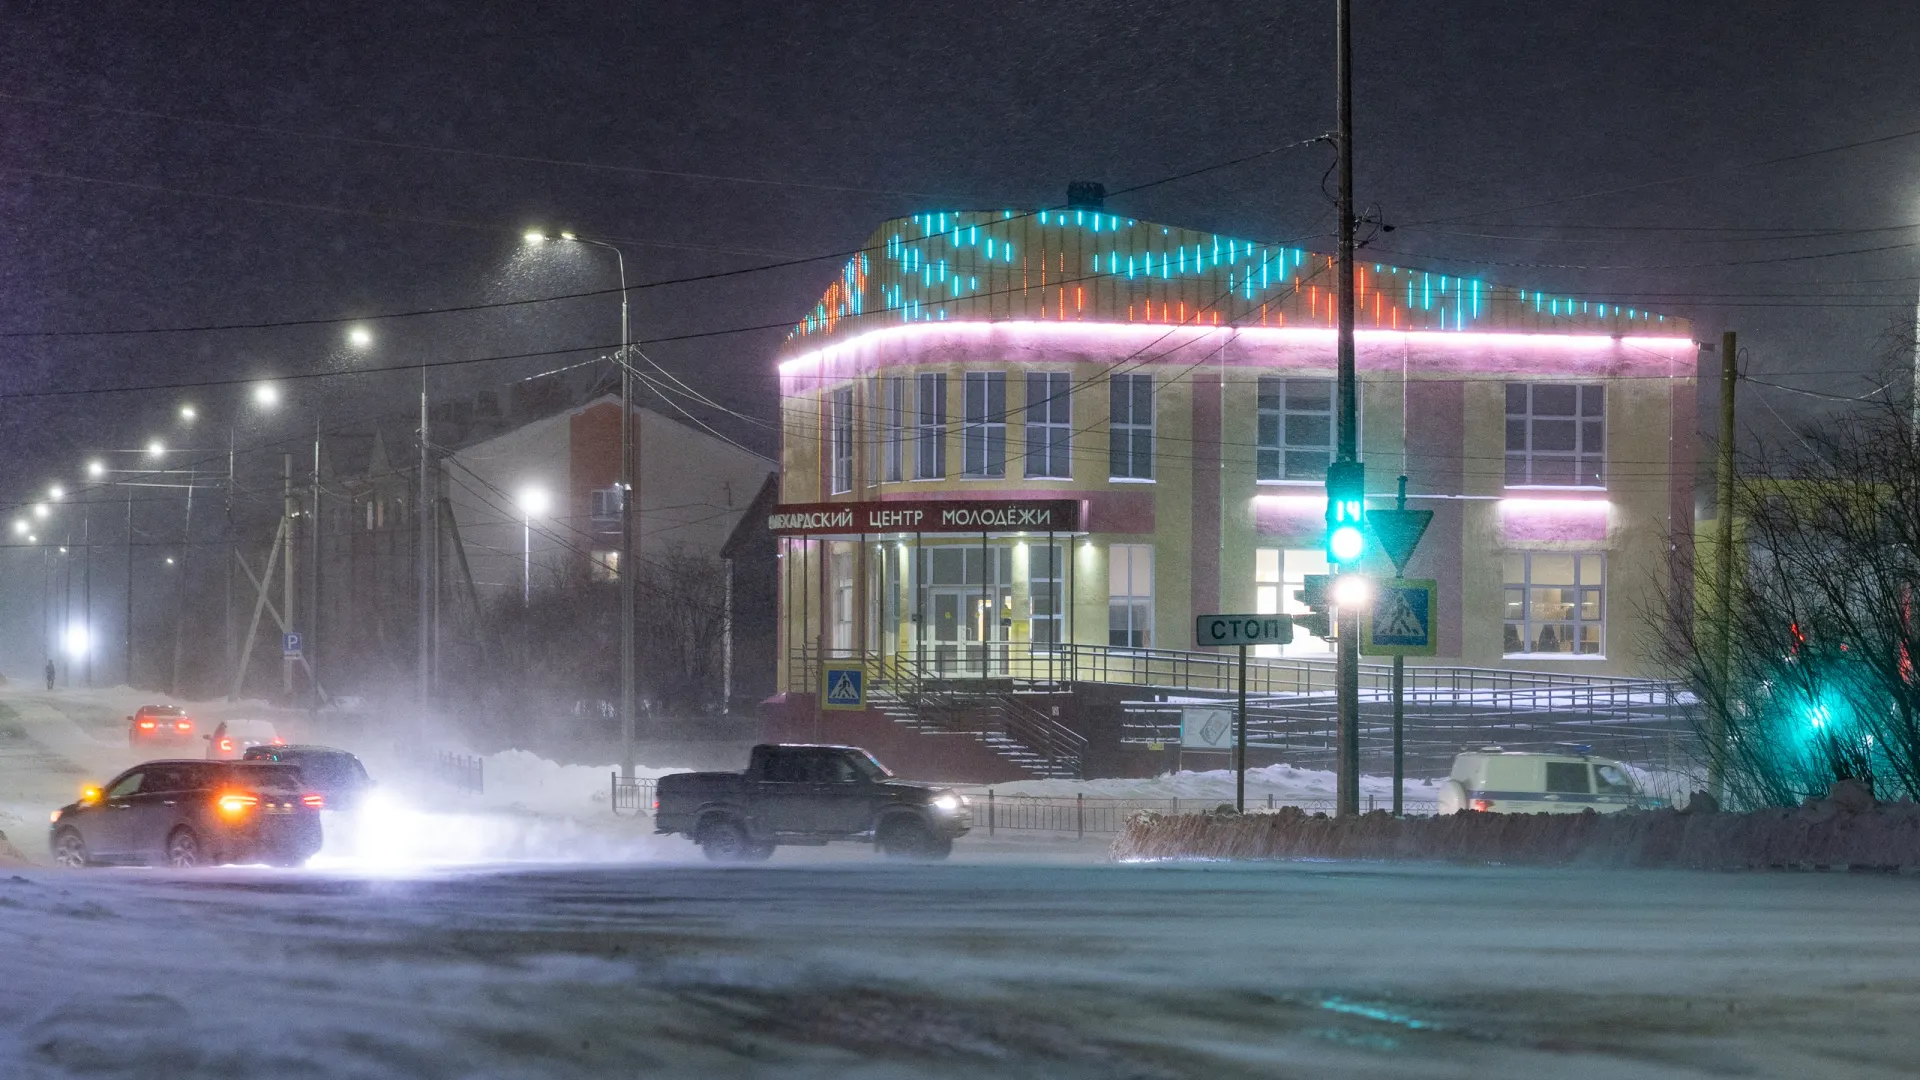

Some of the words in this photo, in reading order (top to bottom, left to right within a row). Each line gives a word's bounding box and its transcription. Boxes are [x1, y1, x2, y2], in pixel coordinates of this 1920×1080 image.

[869, 510, 923, 528] ЦЕНТР
[942, 506, 1051, 526] МОЛОДЁЖИ
[1336, 500, 1360, 522] 14
[1211, 619, 1279, 640] СТОП
[288, 634, 298, 650] P
